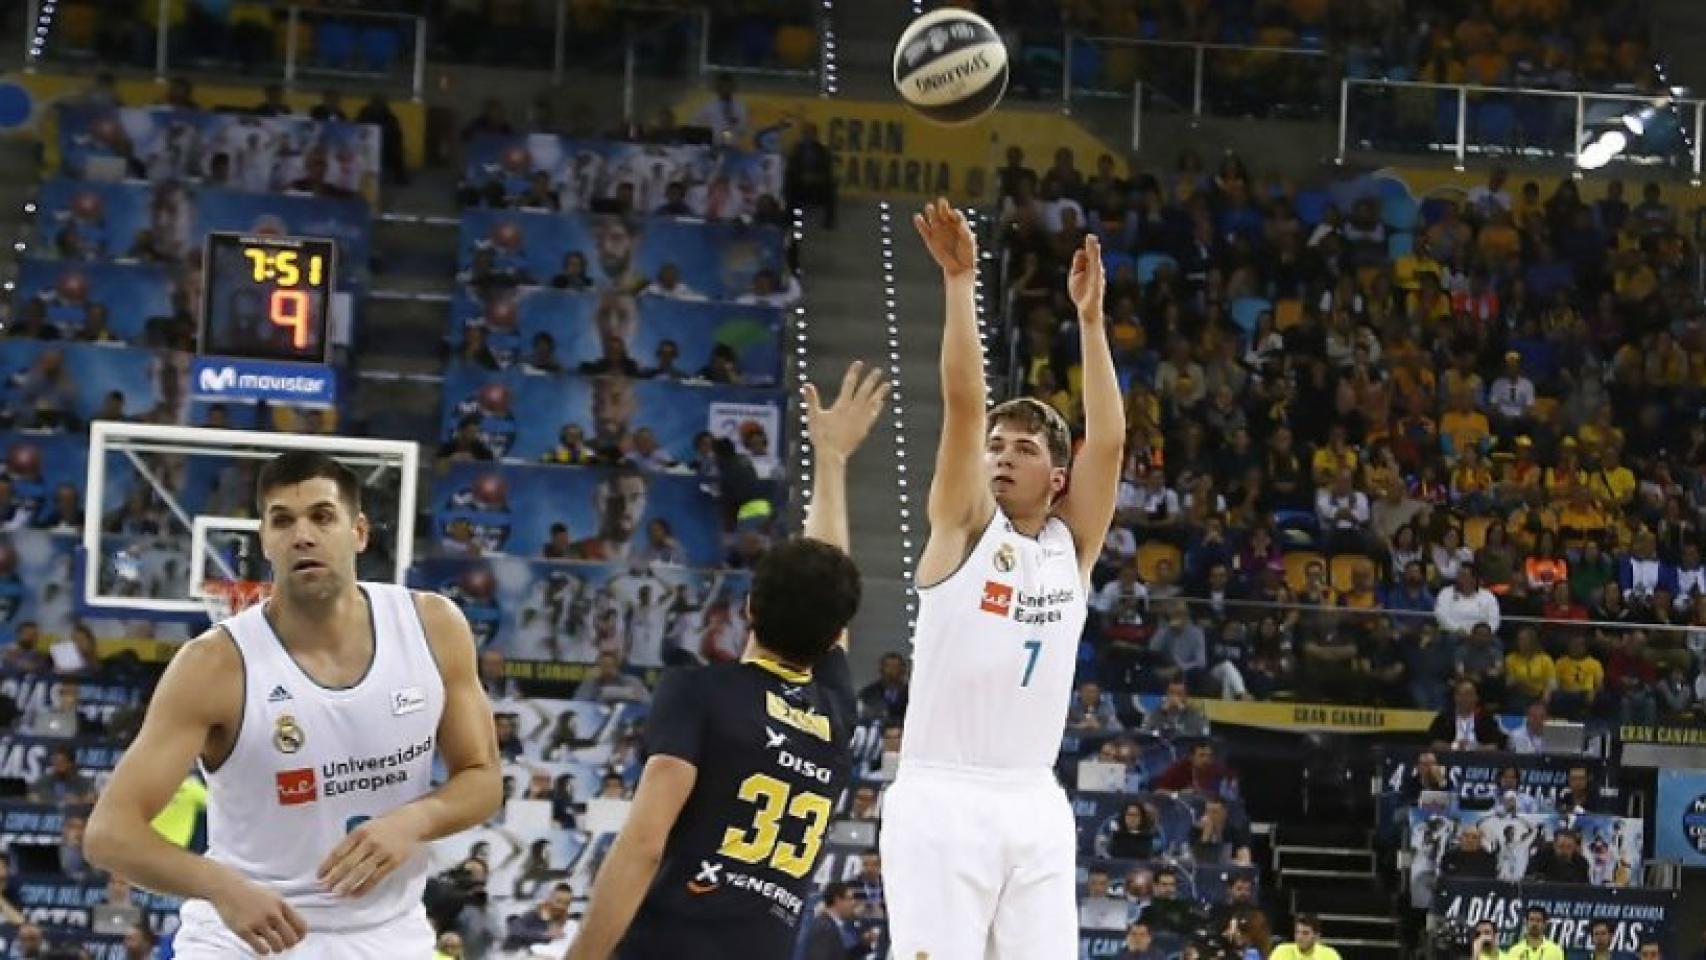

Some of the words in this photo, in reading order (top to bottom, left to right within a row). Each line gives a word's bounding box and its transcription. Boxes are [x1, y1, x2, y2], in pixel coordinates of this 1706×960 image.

[916, 50, 990, 93] SPALDING
[830, 116, 904, 154] GRAN
[832, 154, 950, 194] CANARIA
[244, 247, 323, 287] 7:51
[270, 289, 310, 350] 9
[239, 374, 326, 393] movistar
[1020, 640, 1042, 688] 7
[1294, 708, 1327, 724] GRAN
[1331, 710, 1385, 727] CANARIA
[1620, 725, 1655, 742] GRAN
[323, 736, 432, 779] Universidad
[324, 769, 408, 796] Europea
[717, 772, 832, 879] 33
[1446, 896, 1464, 920] 4
[1466, 892, 1523, 930] DÍAS
